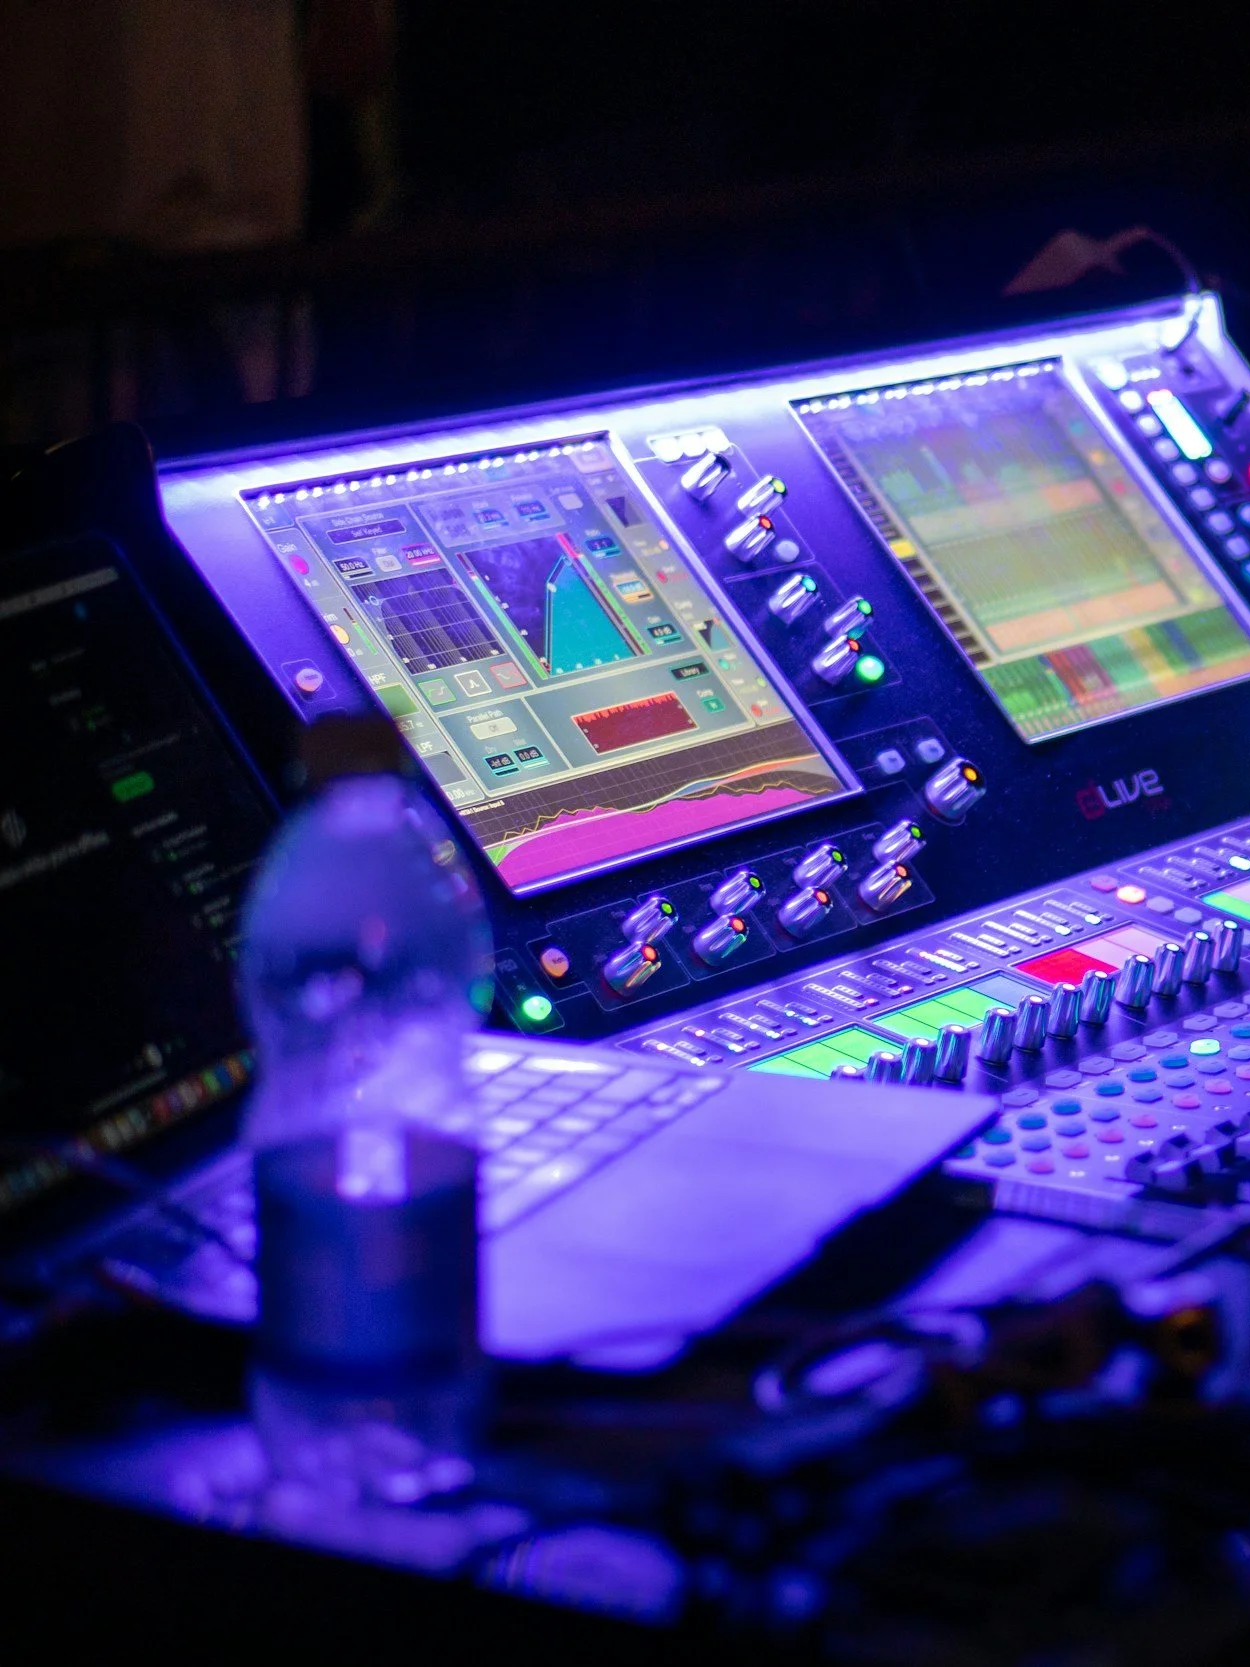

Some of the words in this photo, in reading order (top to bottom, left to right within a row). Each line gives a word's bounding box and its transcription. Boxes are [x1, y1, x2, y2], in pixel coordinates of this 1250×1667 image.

[276, 542, 298, 554] Gain
[367, 672, 387, 685] HPF
[519, 752, 531, 761] 0.0
